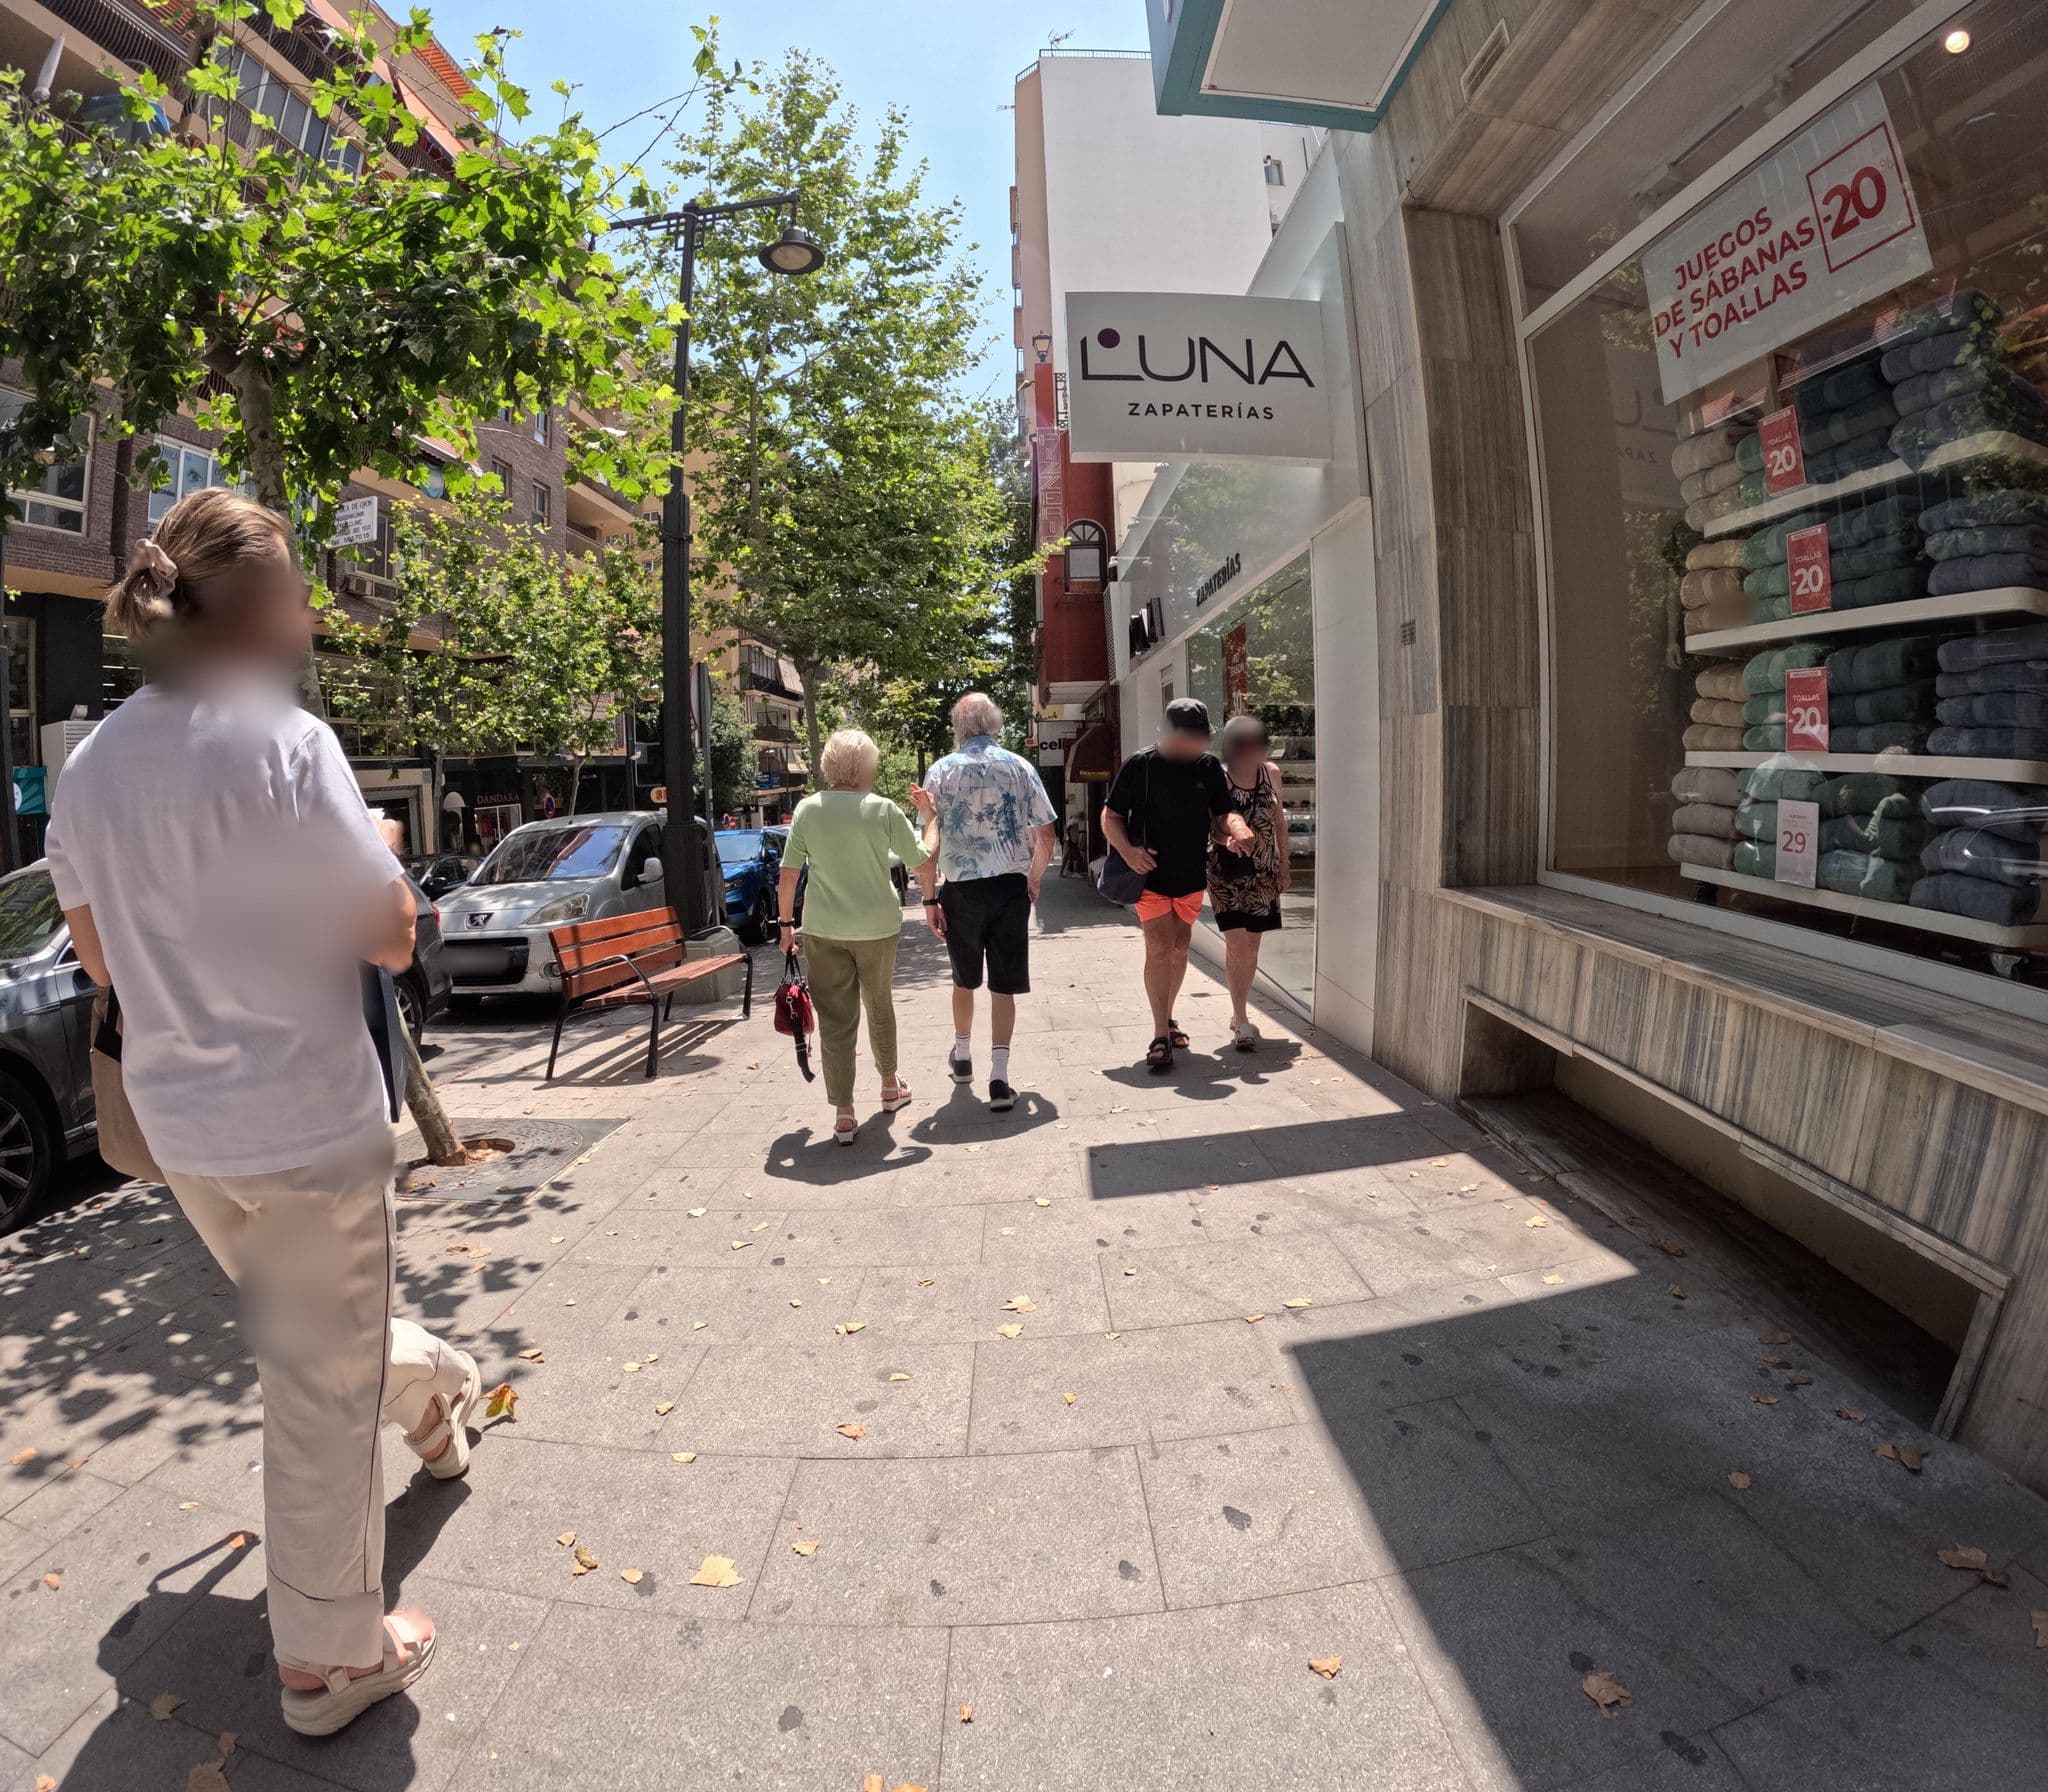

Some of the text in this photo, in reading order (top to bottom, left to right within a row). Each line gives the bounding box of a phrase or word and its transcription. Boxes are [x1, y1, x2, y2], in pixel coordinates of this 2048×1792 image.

[1675, 207, 1772, 290] JUEGOS
[1654, 217, 1815, 338] DE SÁBANAS
[1669, 261, 1808, 358] Y TOALLAS
[1080, 330, 1315, 388] LUNA
[1128, 402, 1274, 420] ZAPATERÍAS
[1768, 432, 1792, 446] TOALLAS
[1795, 551, 1822, 563] TOALLAS
[1196, 552, 1241, 607] ZAPATERÍAS
[1792, 693, 1820, 702] TOALLAS
[1782, 830, 1806, 854] 29
